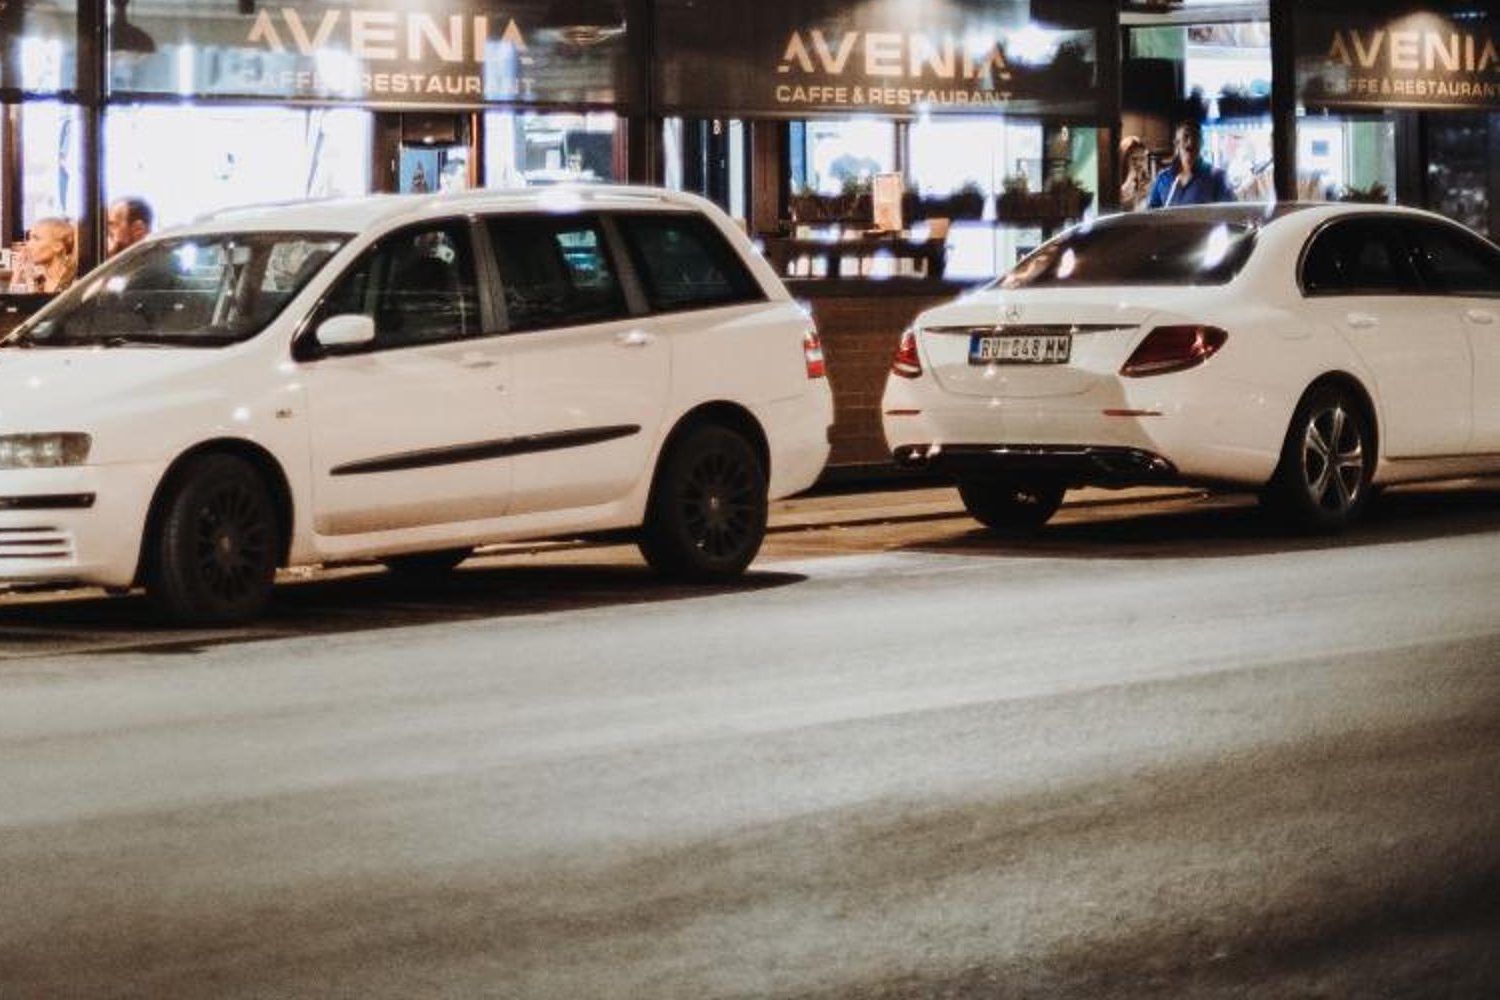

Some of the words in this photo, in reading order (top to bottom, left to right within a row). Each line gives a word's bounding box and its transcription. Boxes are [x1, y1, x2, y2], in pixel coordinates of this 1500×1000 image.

[247, 6, 534, 65] AVENIA
[778, 28, 1011, 81] AVENIA
[1327, 29, 1500, 72] AVENIA
[360, 72, 534, 96] RESTAURT
[776, 85, 847, 104] CAFFE
[852, 85, 864, 104] &
[868, 87, 1012, 107] RESTAURANT
